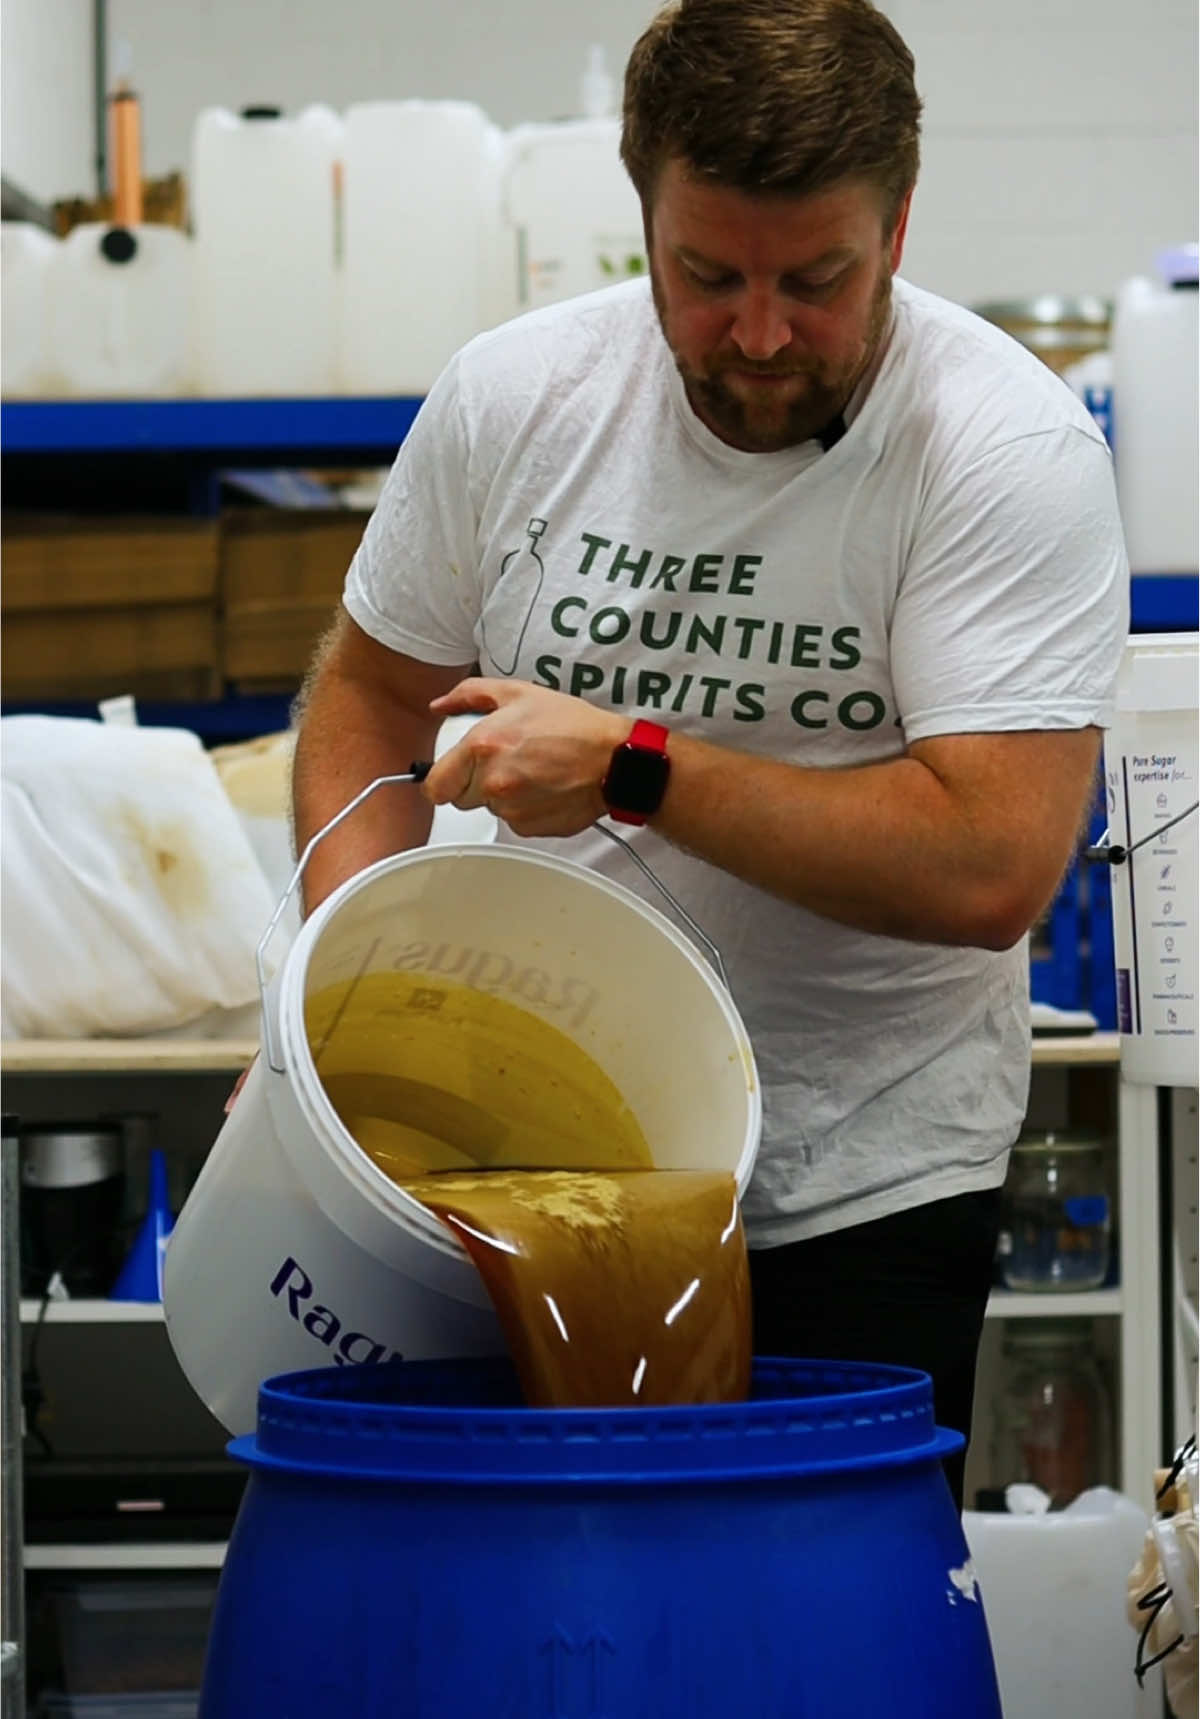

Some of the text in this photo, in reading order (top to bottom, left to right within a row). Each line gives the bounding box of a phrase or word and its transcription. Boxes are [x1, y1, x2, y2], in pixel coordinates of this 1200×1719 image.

[577, 532, 763, 596] THREE
[550, 596, 862, 671] COUNTIES
[532, 655, 766, 722] SPIRITS
[1151, 754, 1176, 769] Sugar
[270, 1256, 404, 1366] Rag
